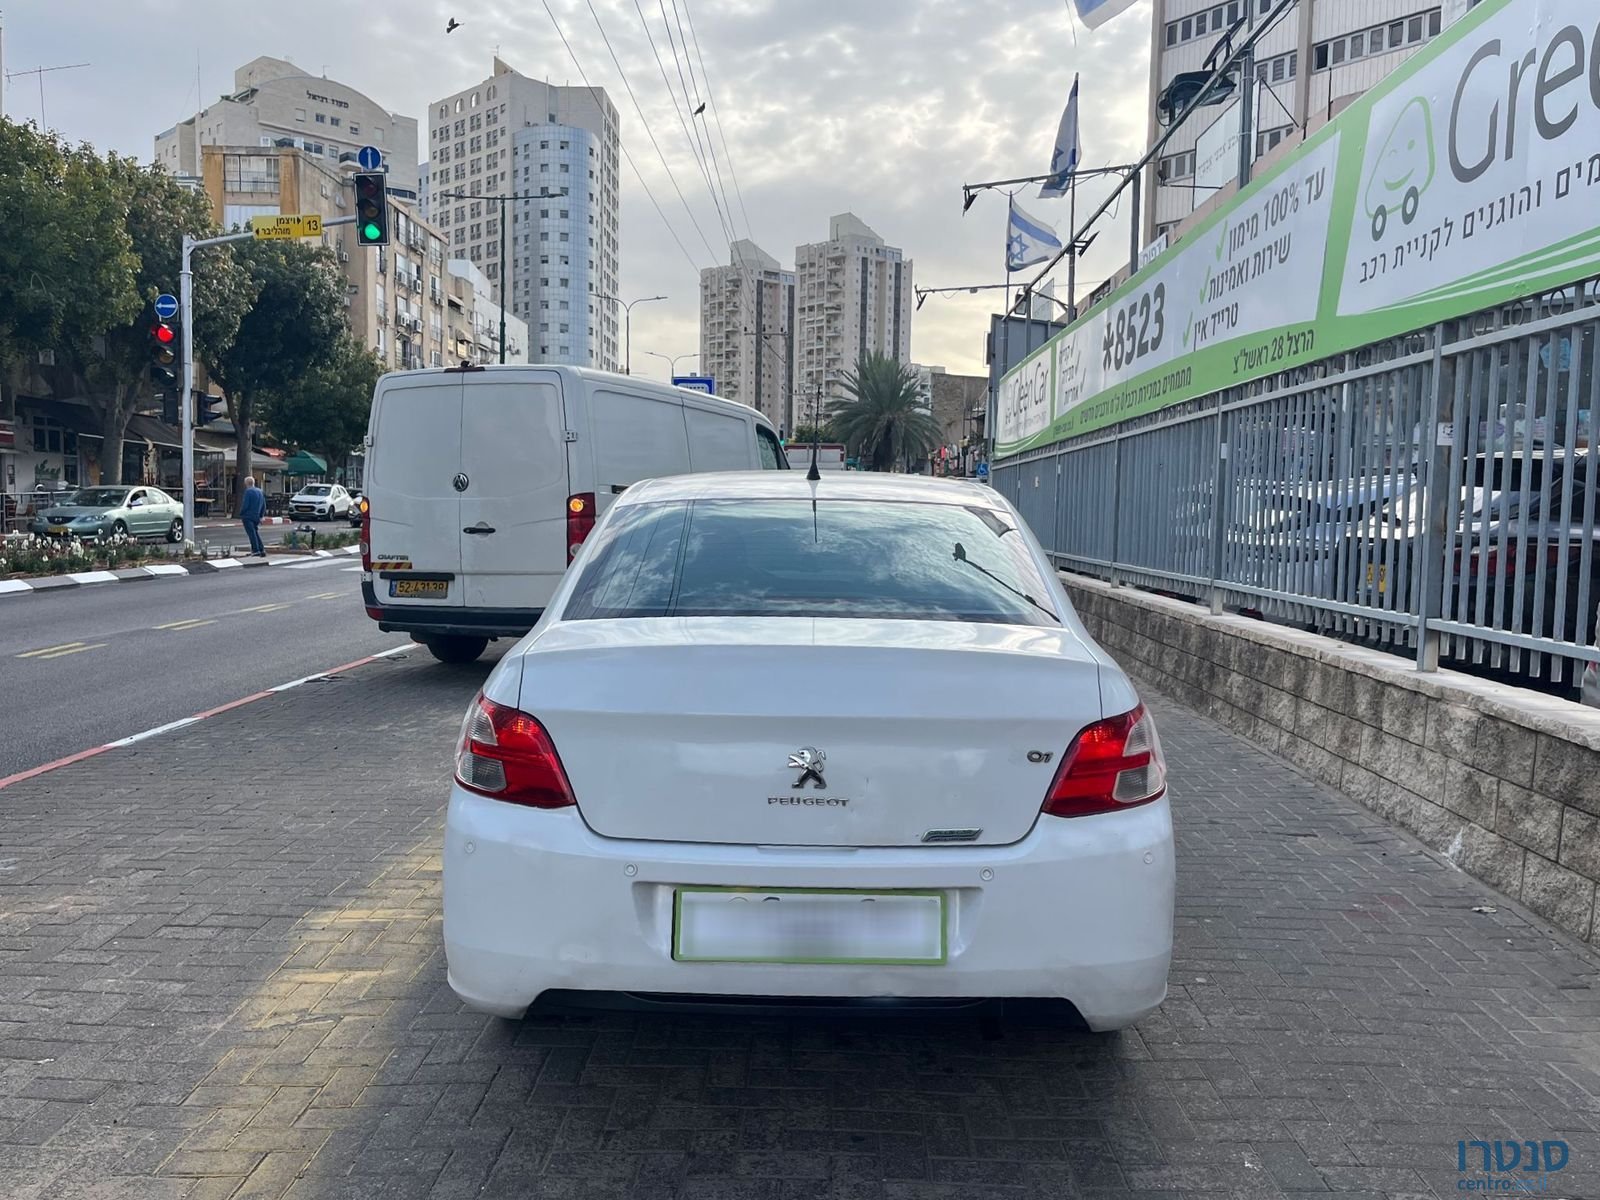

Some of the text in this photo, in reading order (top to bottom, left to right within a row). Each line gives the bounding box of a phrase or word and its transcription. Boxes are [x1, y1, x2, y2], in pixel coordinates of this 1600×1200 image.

[1448, 22, 1600, 183] Gre
[276, 217, 296, 227] ויצמן
[307, 219, 318, 231] 13
[1228, 167, 1326, 262] עד 100% מימון
[1463, 180, 1542, 239] והוגנים
[1393, 217, 1454, 270] לקניית
[1208, 232, 1291, 303] שירות ואמינות
[1359, 252, 1387, 283] רכב
[1193, 302, 1239, 352] טרייד אין
[1271, 335, 1284, 362] 28
[1287, 329, 1314, 357] הרצל
[1162, 366, 1192, 395] מתמחים
[767, 797, 849, 807] PEUGEOT
